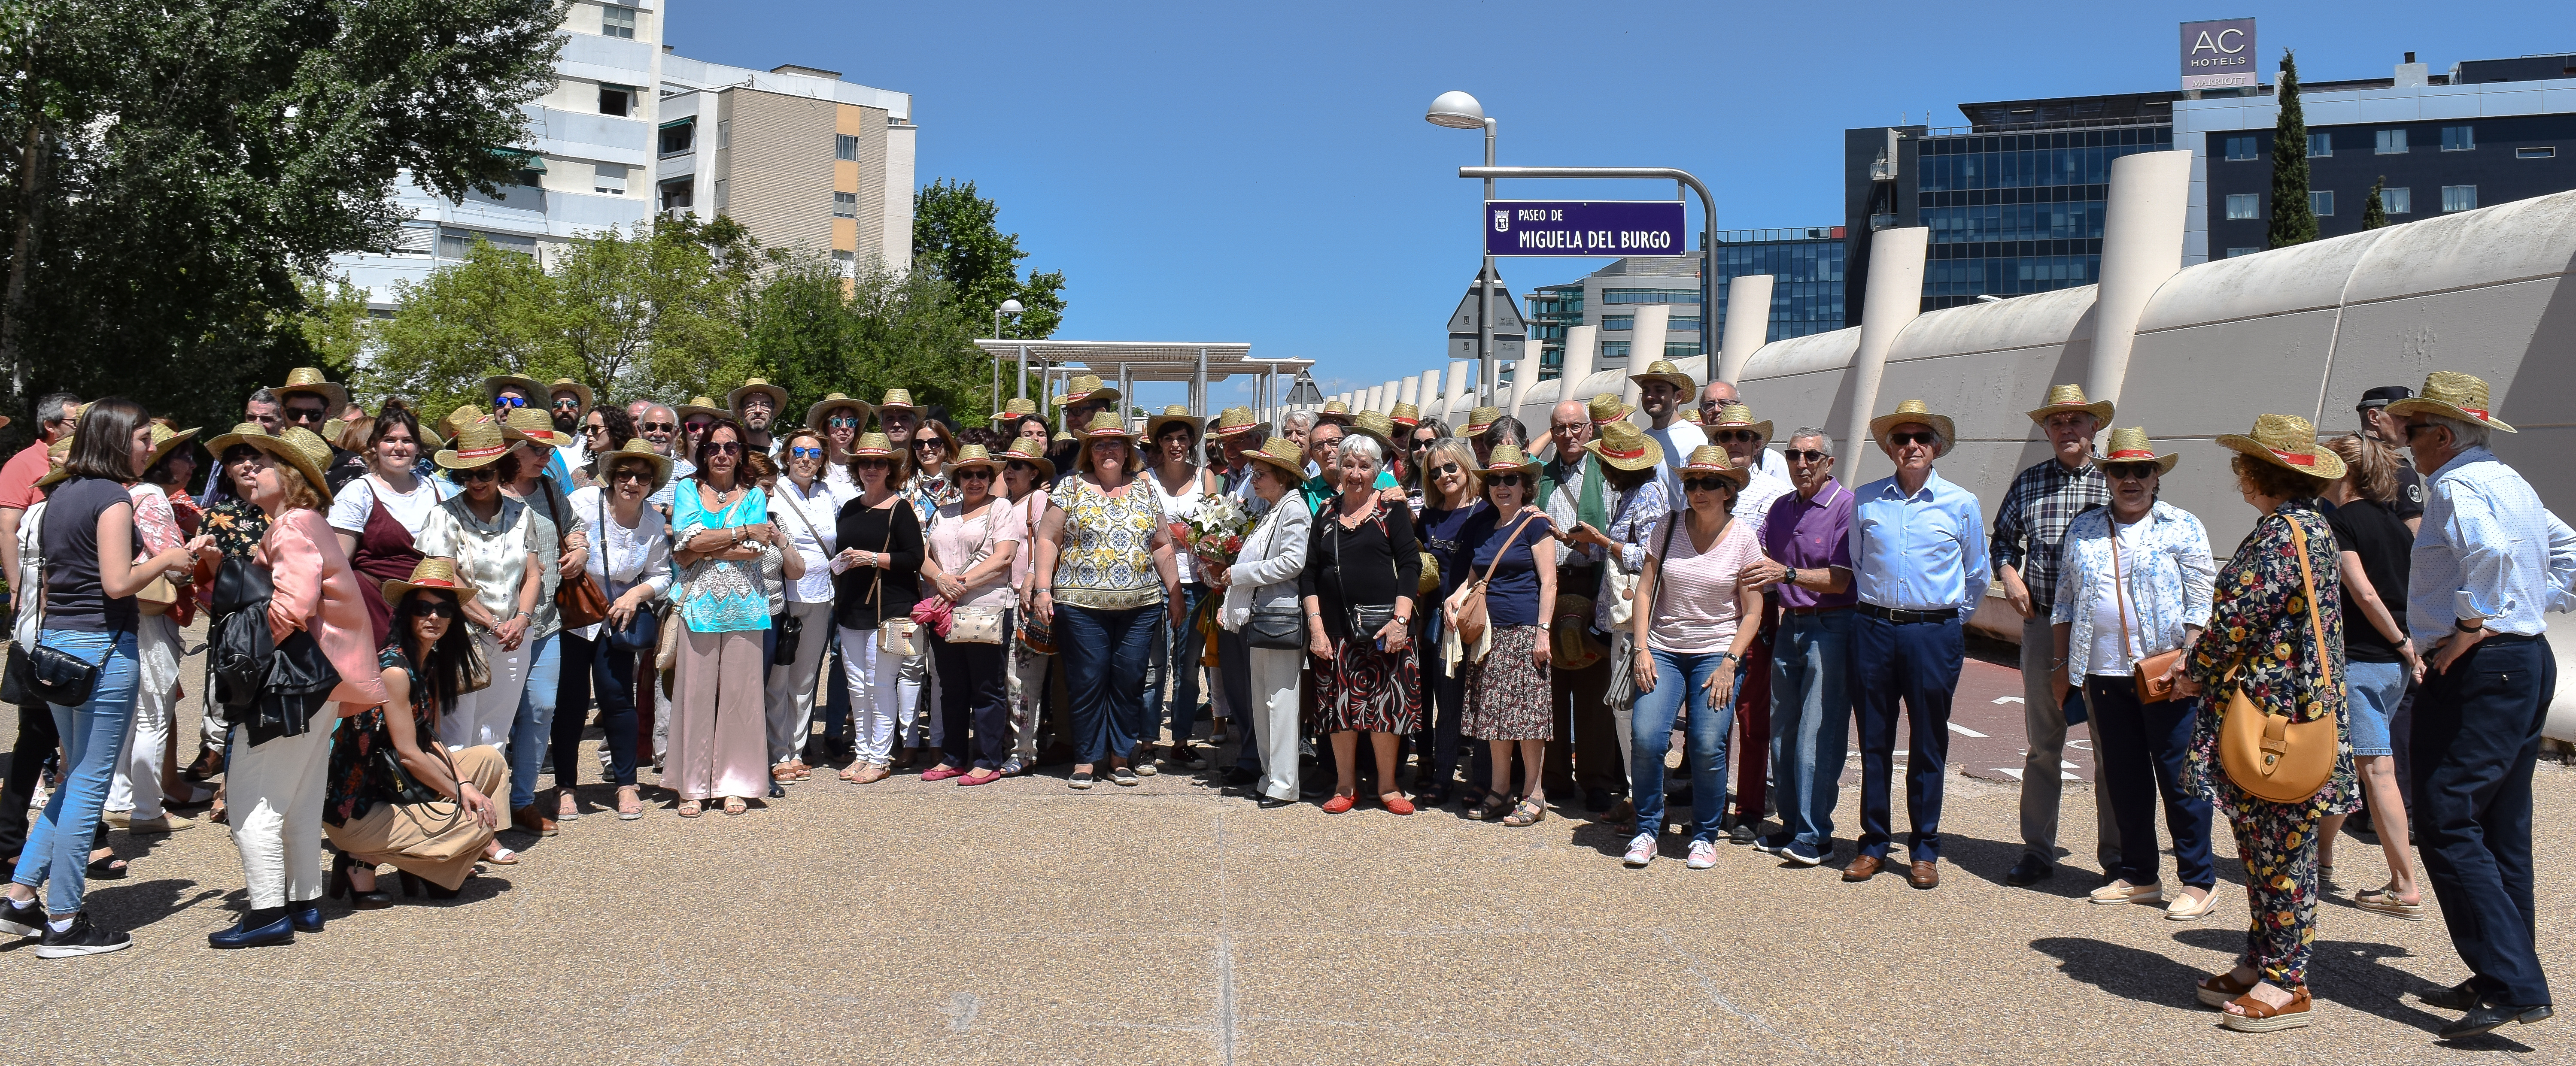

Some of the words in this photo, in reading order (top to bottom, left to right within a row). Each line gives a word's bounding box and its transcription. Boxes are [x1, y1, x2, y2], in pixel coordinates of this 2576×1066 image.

[2191, 29, 2245, 55] AC
[2191, 57, 2245, 67] HOTELS
[2192, 77, 2246, 87] MARRIOTT
[1519, 209, 1546, 221] PASEO
[1551, 209, 1563, 221] DE
[1519, 231, 1583, 248] MIGUELA
[1589, 231, 1616, 248] DEL
[1621, 231, 1671, 248] BURGO
